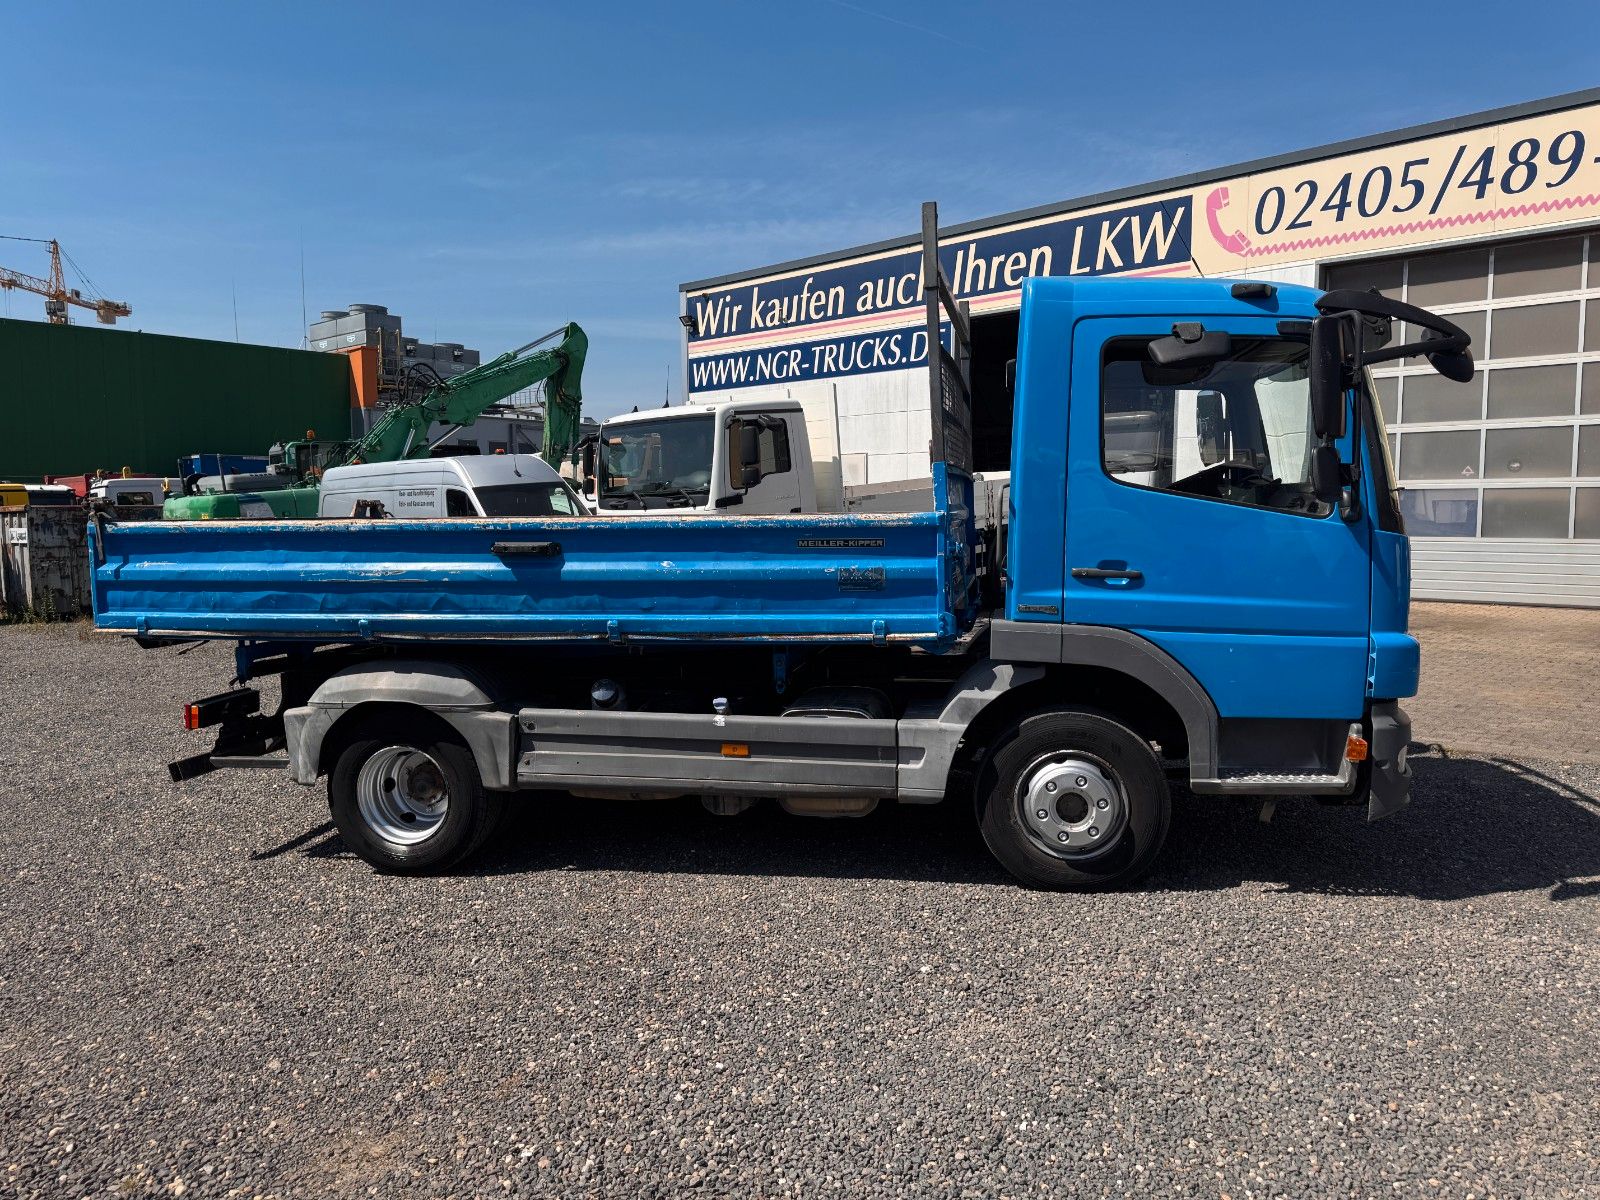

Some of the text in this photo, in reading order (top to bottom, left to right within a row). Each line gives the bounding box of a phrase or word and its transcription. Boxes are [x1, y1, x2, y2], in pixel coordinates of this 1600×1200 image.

[696, 295, 742, 337] Wir
[750, 277, 845, 329] kaufen
[953, 243, 1053, 294] Ihren
[1070, 207, 1186, 275] LKW
[692, 328, 946, 387] WWW.NGR-TRUCKS.D
[798, 539, 884, 547] MEILLER-KIPPER
